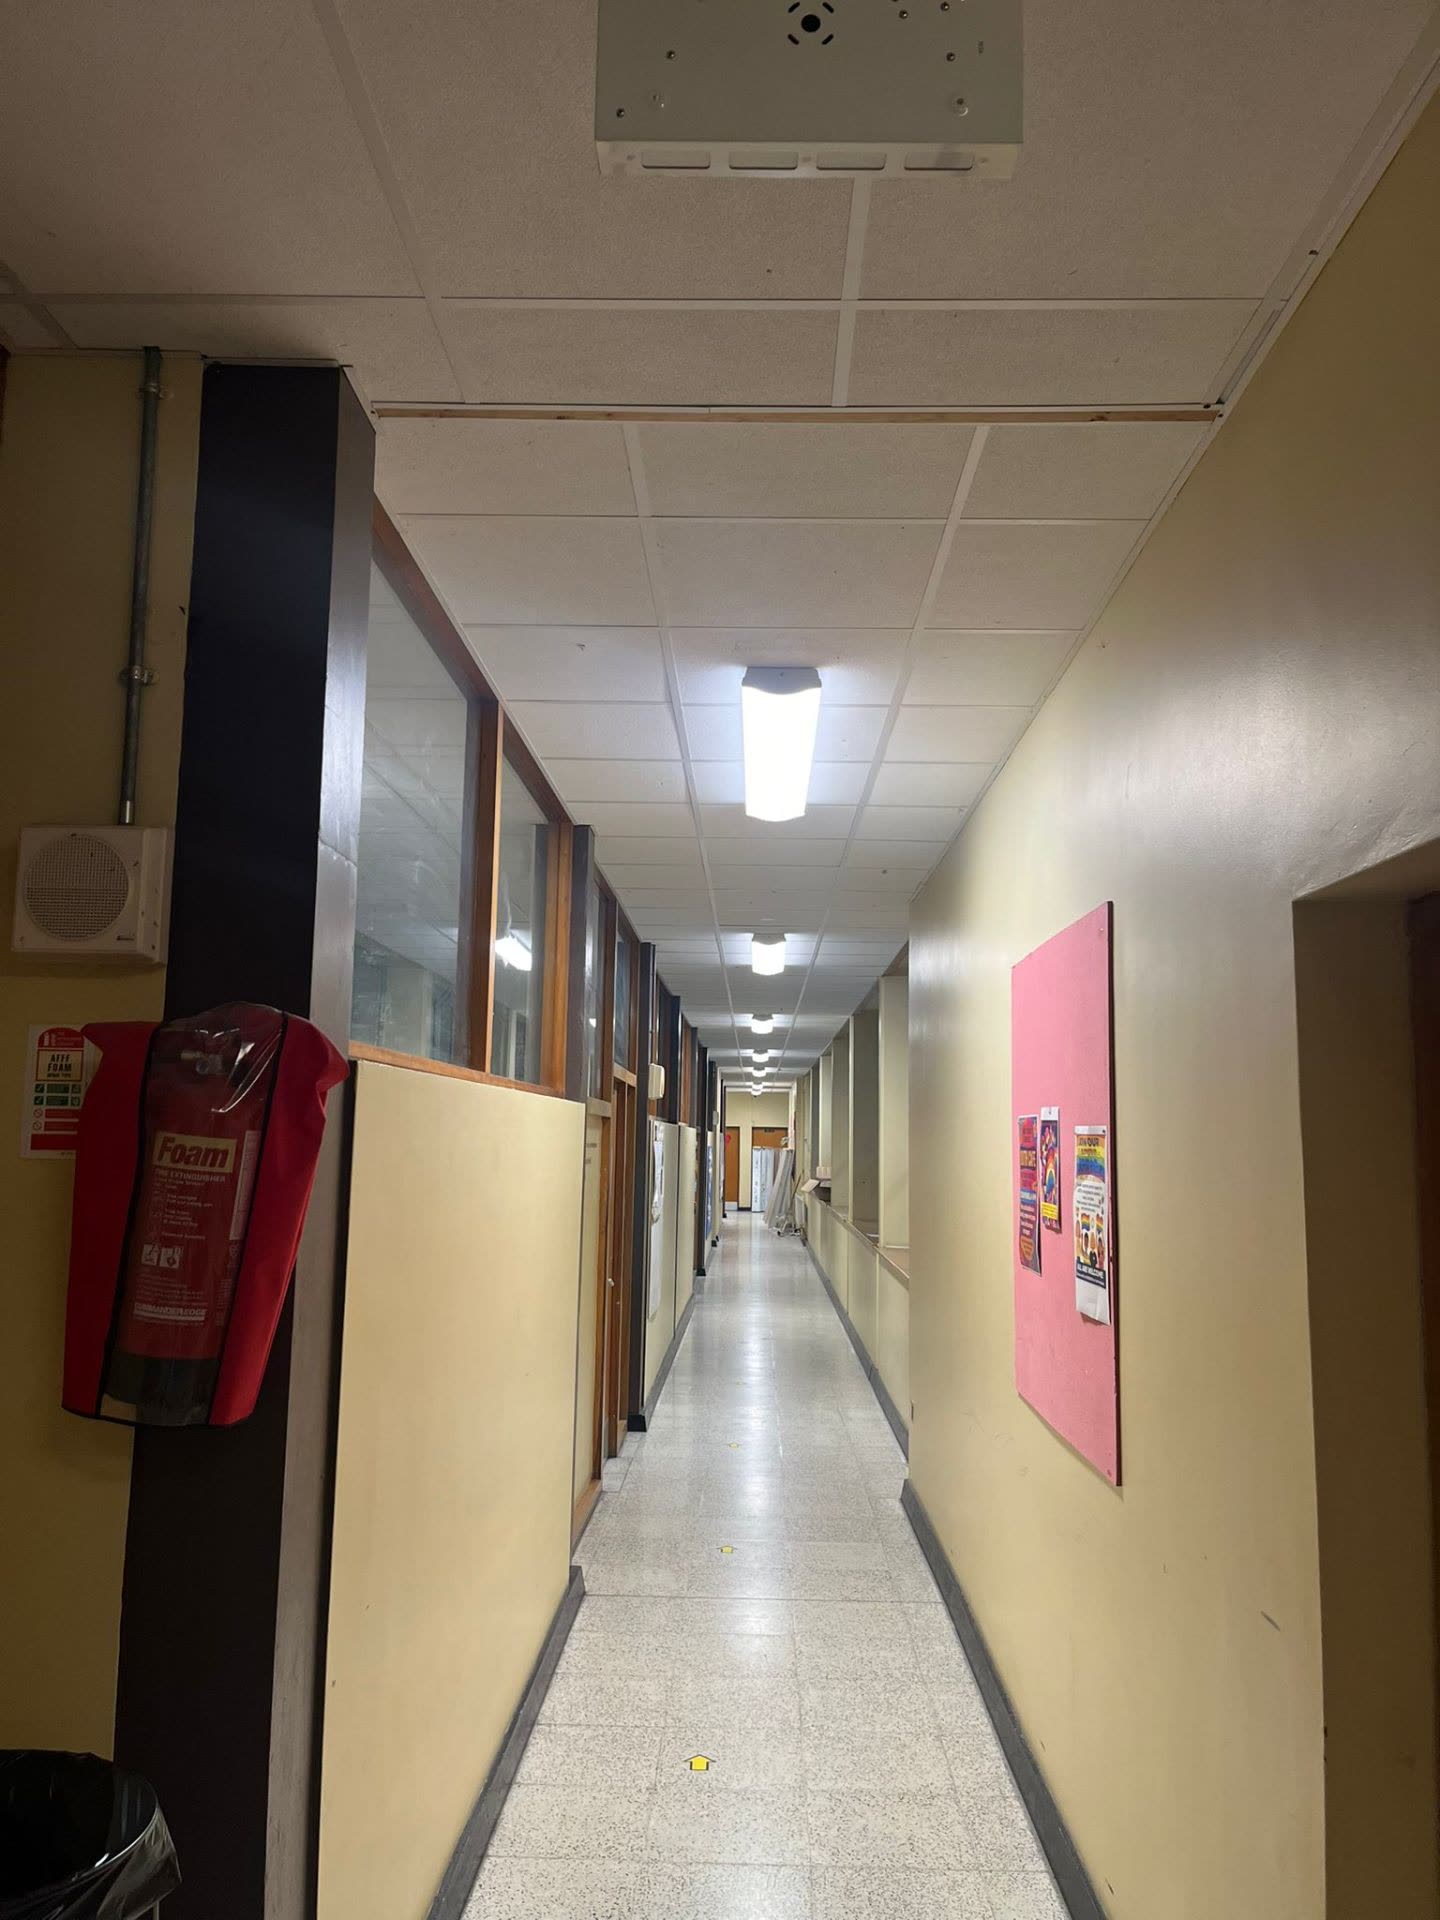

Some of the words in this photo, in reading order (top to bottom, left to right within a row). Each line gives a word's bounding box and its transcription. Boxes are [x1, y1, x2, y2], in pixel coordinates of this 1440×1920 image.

[50, 1054, 70, 1062] AFFF
[47, 1063, 72, 1072] FOAM
[158, 1135, 230, 1169] Foam
[170, 1170, 226, 1183] EXTINGUISHER
